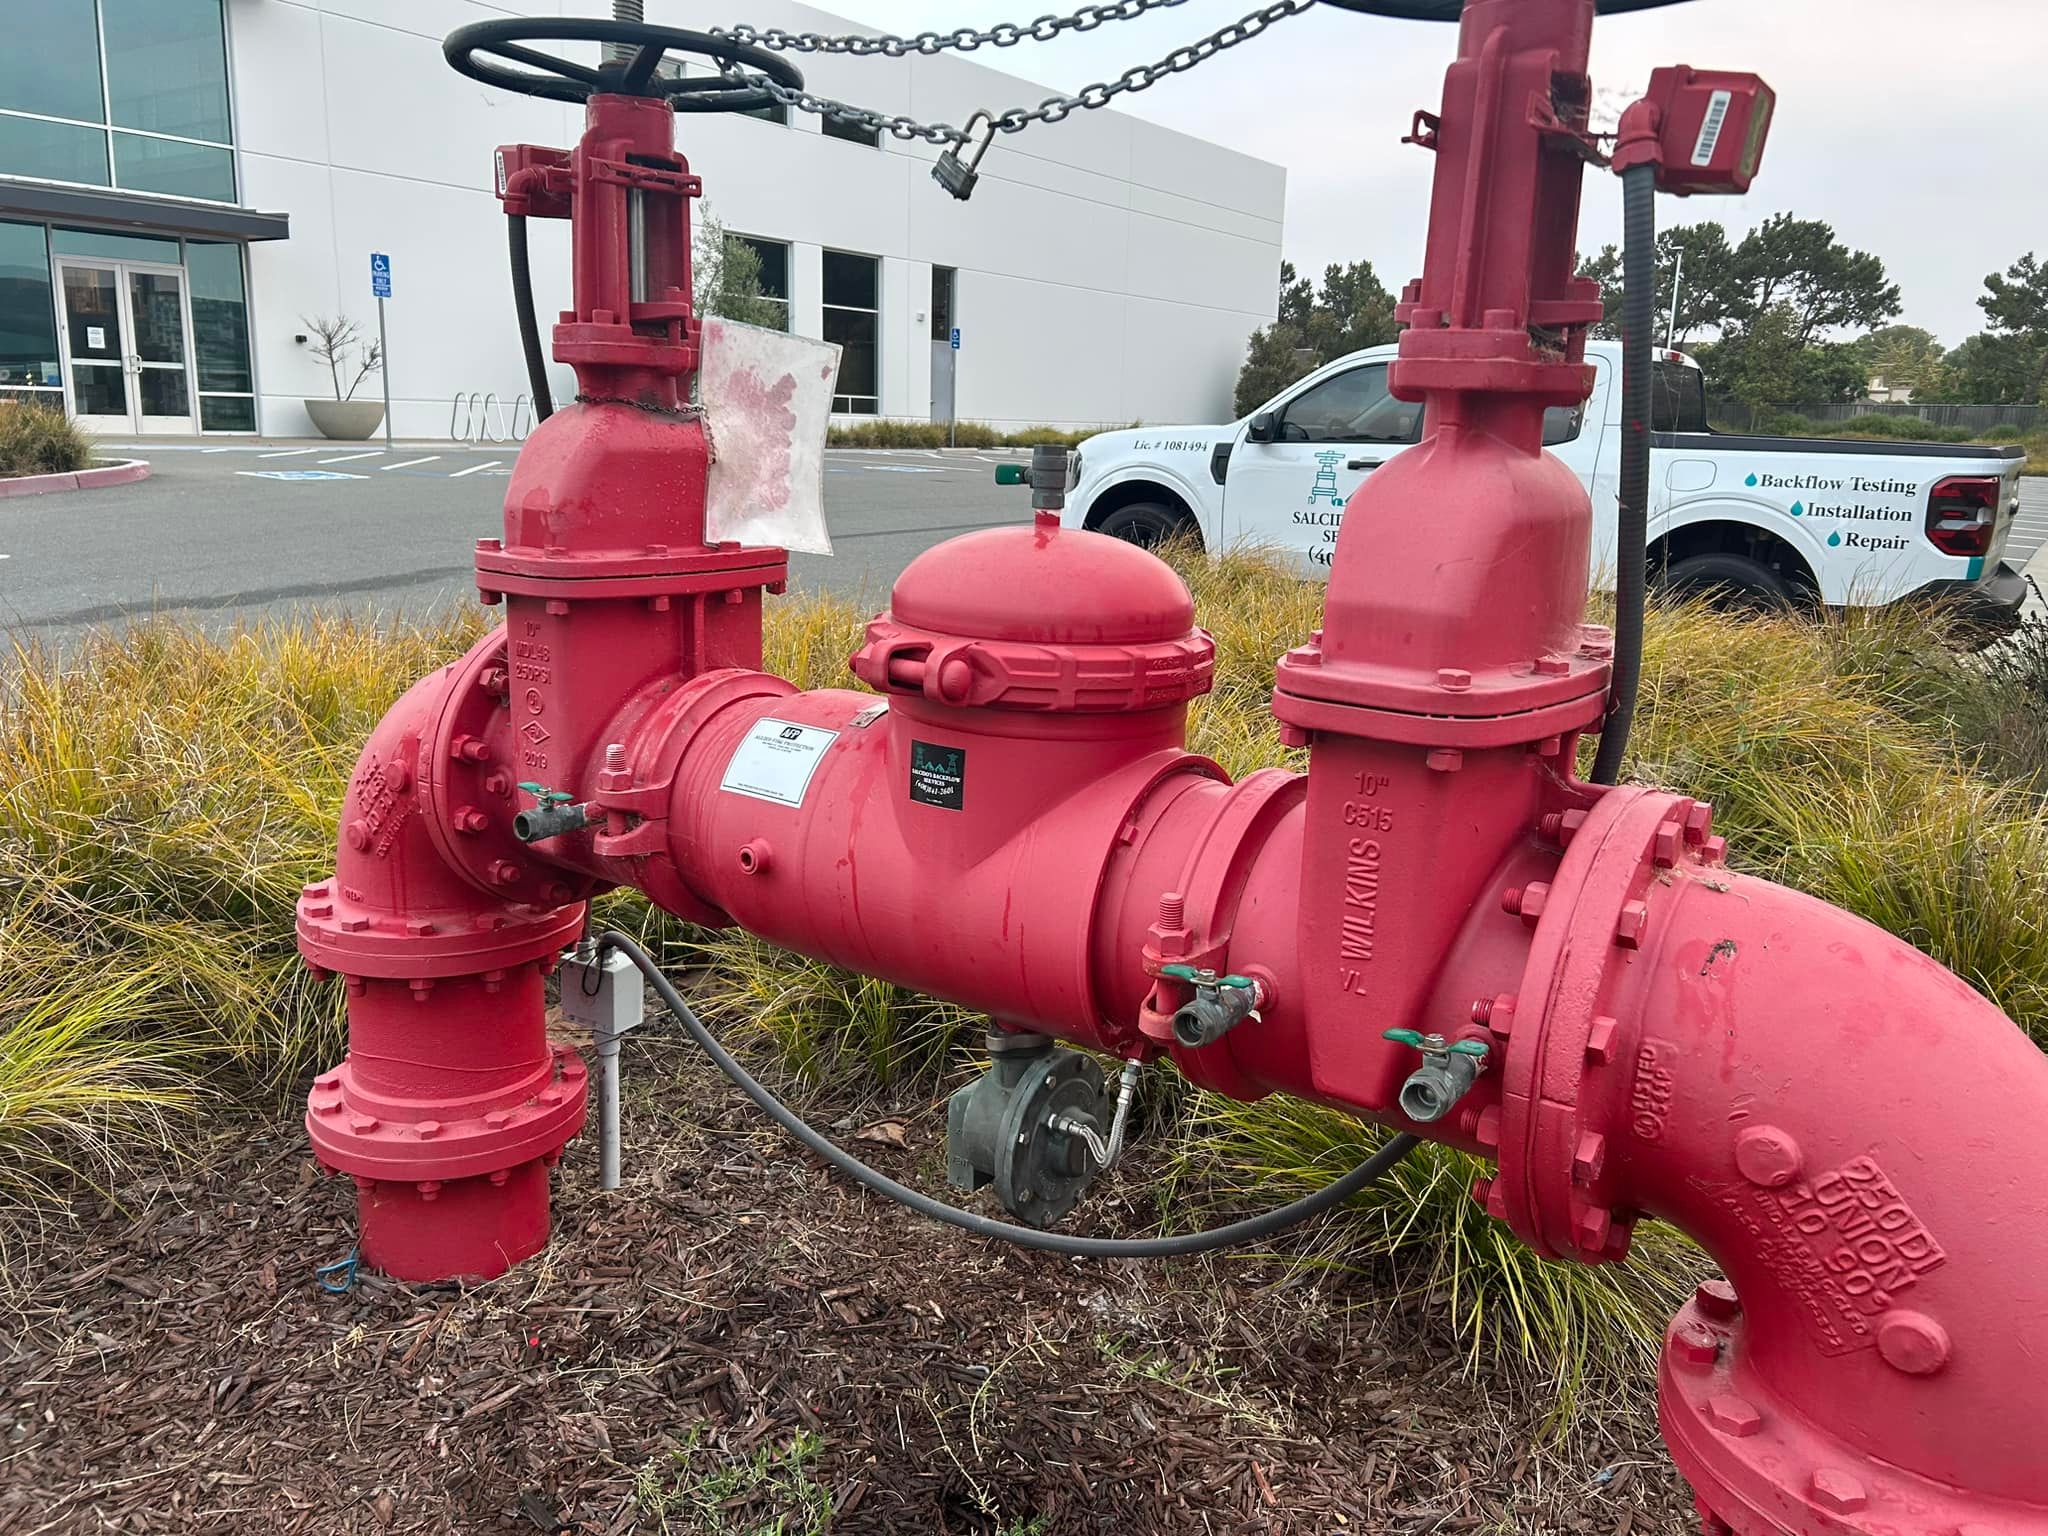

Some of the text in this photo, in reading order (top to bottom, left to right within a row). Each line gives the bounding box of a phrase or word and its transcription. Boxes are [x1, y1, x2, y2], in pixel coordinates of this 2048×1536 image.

[1133, 440, 1151, 450] Lic.
[1164, 440, 1208, 452] 1081494
[1760, 474, 1917, 497] Backflow Testing
[1806, 502, 1912, 522] Installation
[1845, 532, 1909, 551] Repair
[1355, 772, 1389, 796] 10"
[1343, 801, 1392, 832] C515
[1341, 838, 1380, 961] WILKINS
[1632, 1045, 1656, 1112] LISTED
[1777, 1183, 1829, 1234] 10
[1814, 1173, 1917, 1292] UNION
